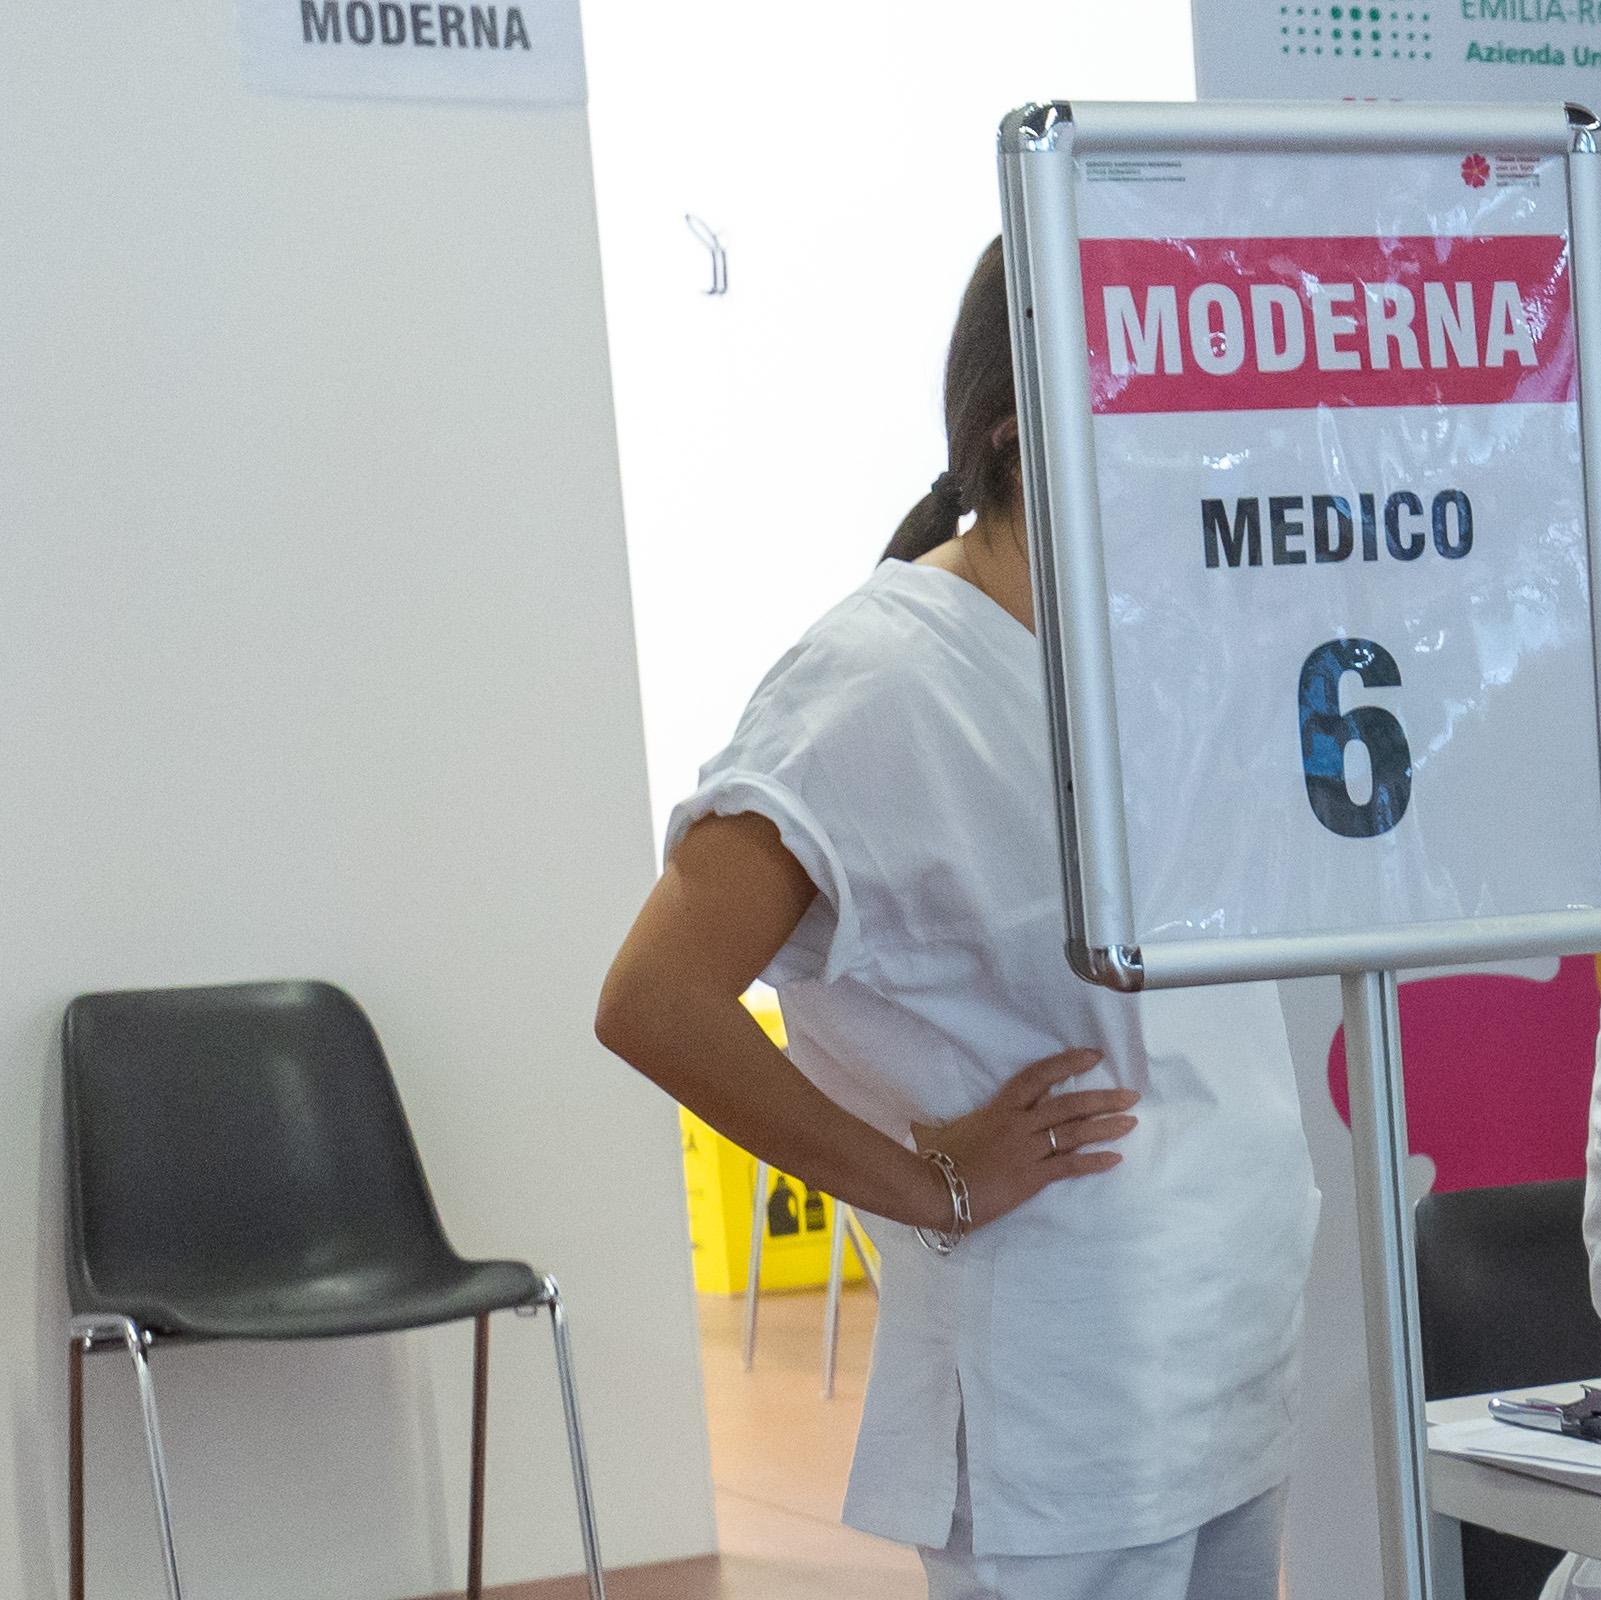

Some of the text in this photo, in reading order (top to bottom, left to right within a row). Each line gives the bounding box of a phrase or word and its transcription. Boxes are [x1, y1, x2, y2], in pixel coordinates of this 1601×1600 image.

[301, 0, 532, 51] MODERNA
[1465, 40, 1565, 66] Azienda
[1103, 281, 1539, 375] MODERNA
[1202, 489, 1474, 568] MEDICO
[1297, 638, 1412, 838] 6
